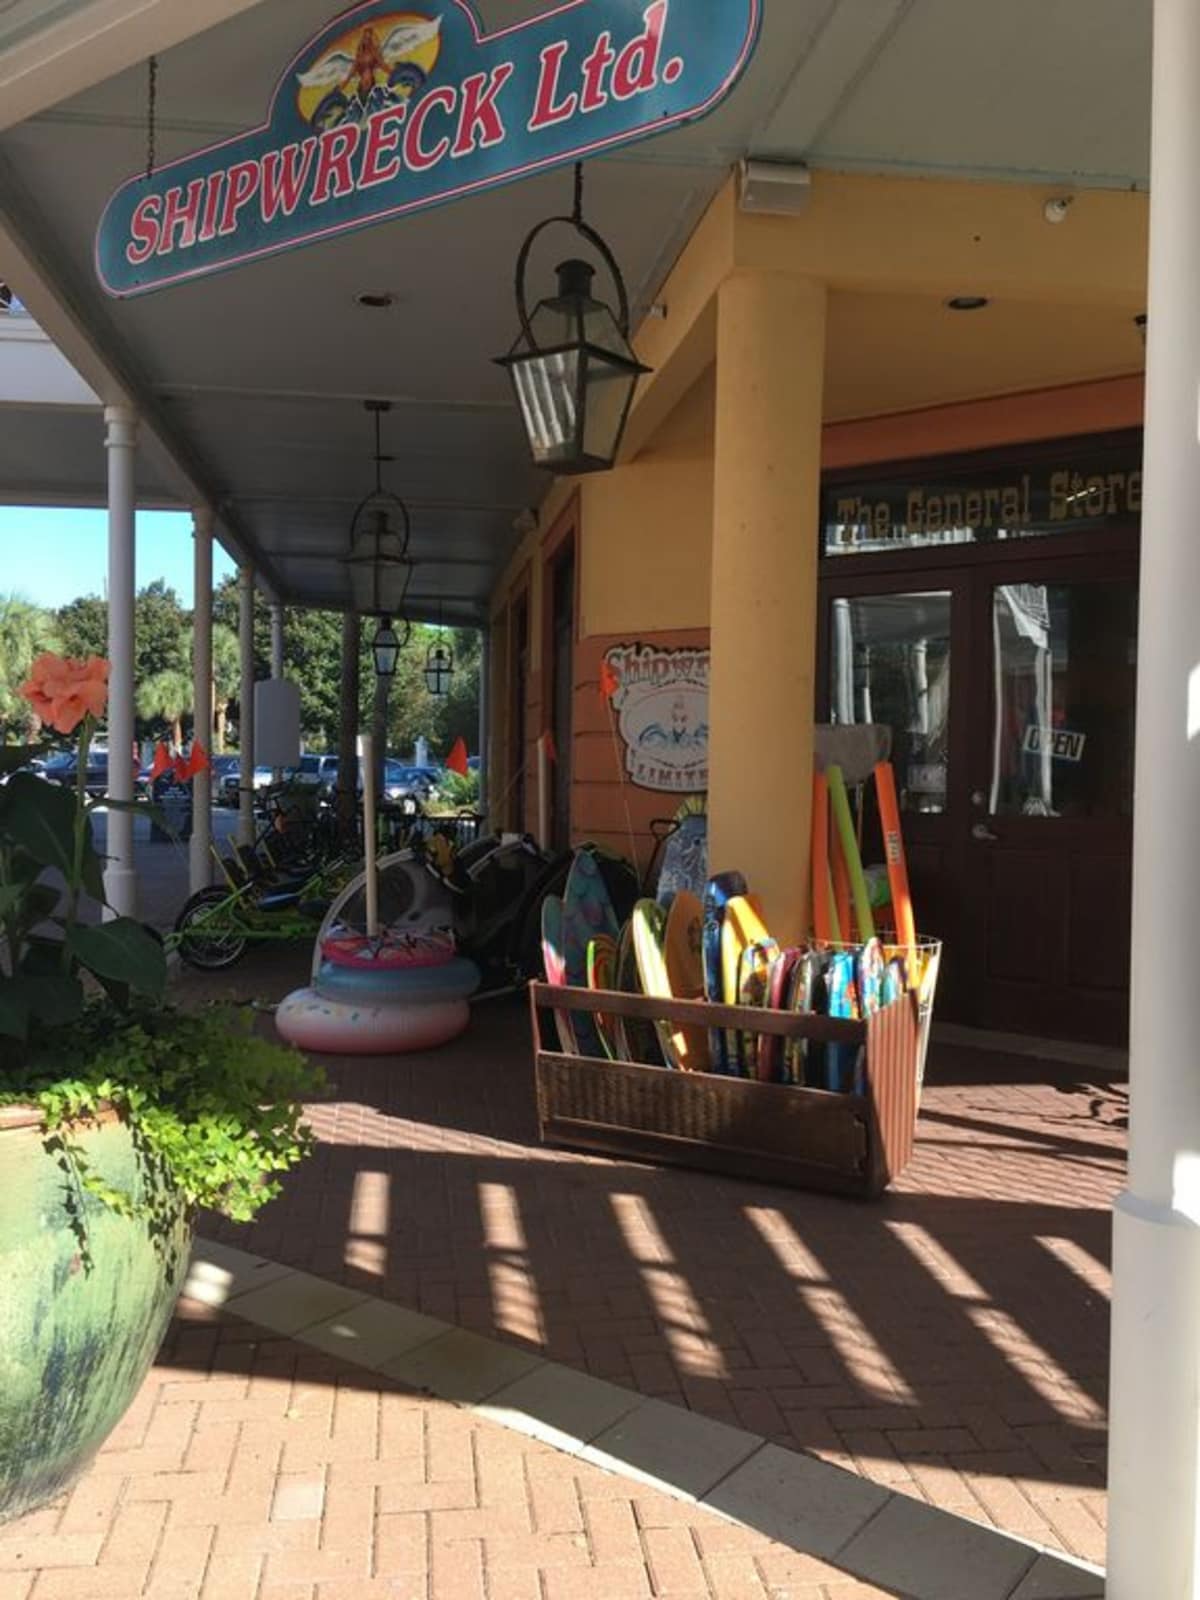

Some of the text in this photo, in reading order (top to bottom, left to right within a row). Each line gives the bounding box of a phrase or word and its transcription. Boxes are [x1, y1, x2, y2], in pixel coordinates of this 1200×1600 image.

[126, 0, 684, 265] SHIPWRECK Ltd.
[836, 470, 1142, 544] The General Store
